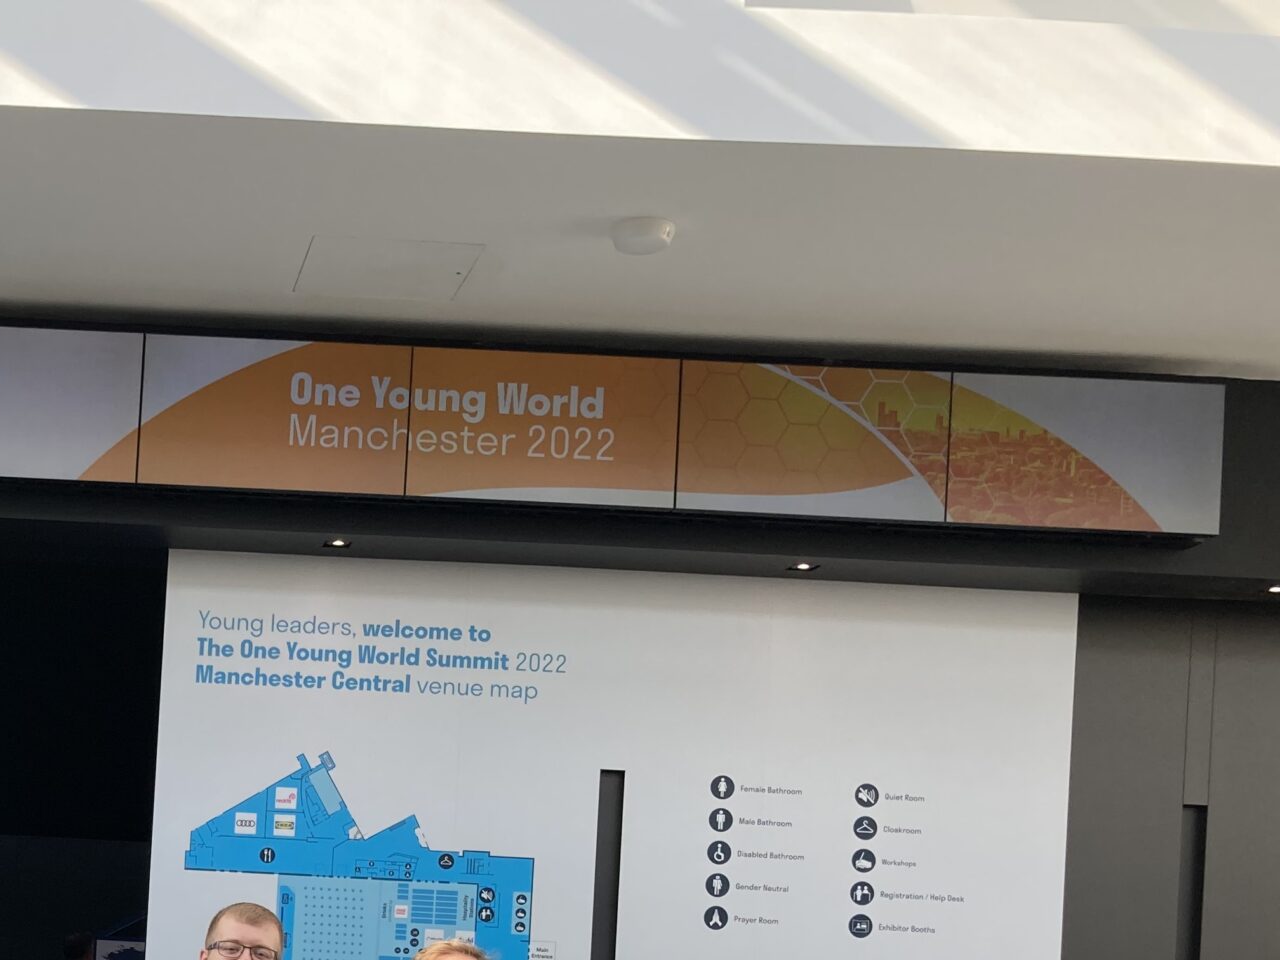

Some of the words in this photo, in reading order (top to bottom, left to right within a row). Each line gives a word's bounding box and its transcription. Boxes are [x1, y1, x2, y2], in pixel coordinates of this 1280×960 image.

[290, 372, 361, 409] One
[371, 376, 487, 424] Young
[497, 382, 605, 420] World
[289, 414, 516, 456] Manchester
[528, 425, 615, 461] 2022
[199, 610, 264, 637] Young
[270, 614, 356, 639] leaders,
[362, 620, 462, 642] welcome
[468, 625, 491, 643] to
[197, 637, 234, 658] The
[240, 639, 281, 660] One
[287, 642, 352, 669] Young
[358, 645, 420, 666] World
[426, 648, 509, 671] Summit
[516, 652, 567, 674] 2022
[195, 665, 326, 690] Manchester
[332, 670, 411, 693] Central
[417, 679, 483, 697] venue
[490, 683, 538, 704] map
[740, 785, 766, 794] Female
[767, 786, 803, 796] Bathroom
[885, 793, 904, 802] Quiet
[905, 794, 925, 803] Room
[739, 817, 755, 826] Male
[757, 818, 792, 828] Bathroom
[883, 825, 922, 835] Cloakroom
[737, 850, 768, 860] Disabled
[769, 851, 805, 861] Bathroom
[881, 858, 917, 868] Workshops
[735, 883, 761, 892] Gender
[763, 884, 789, 893] Neutral
[880, 890, 924, 902] Registration
[930, 893, 946, 903] Help
[947, 894, 964, 903] Desk
[734, 915, 757, 926] Prayer
[758, 917, 779, 926] Room
[878, 923, 909, 933] Exhibitor
[910, 925, 936, 934] Booths
